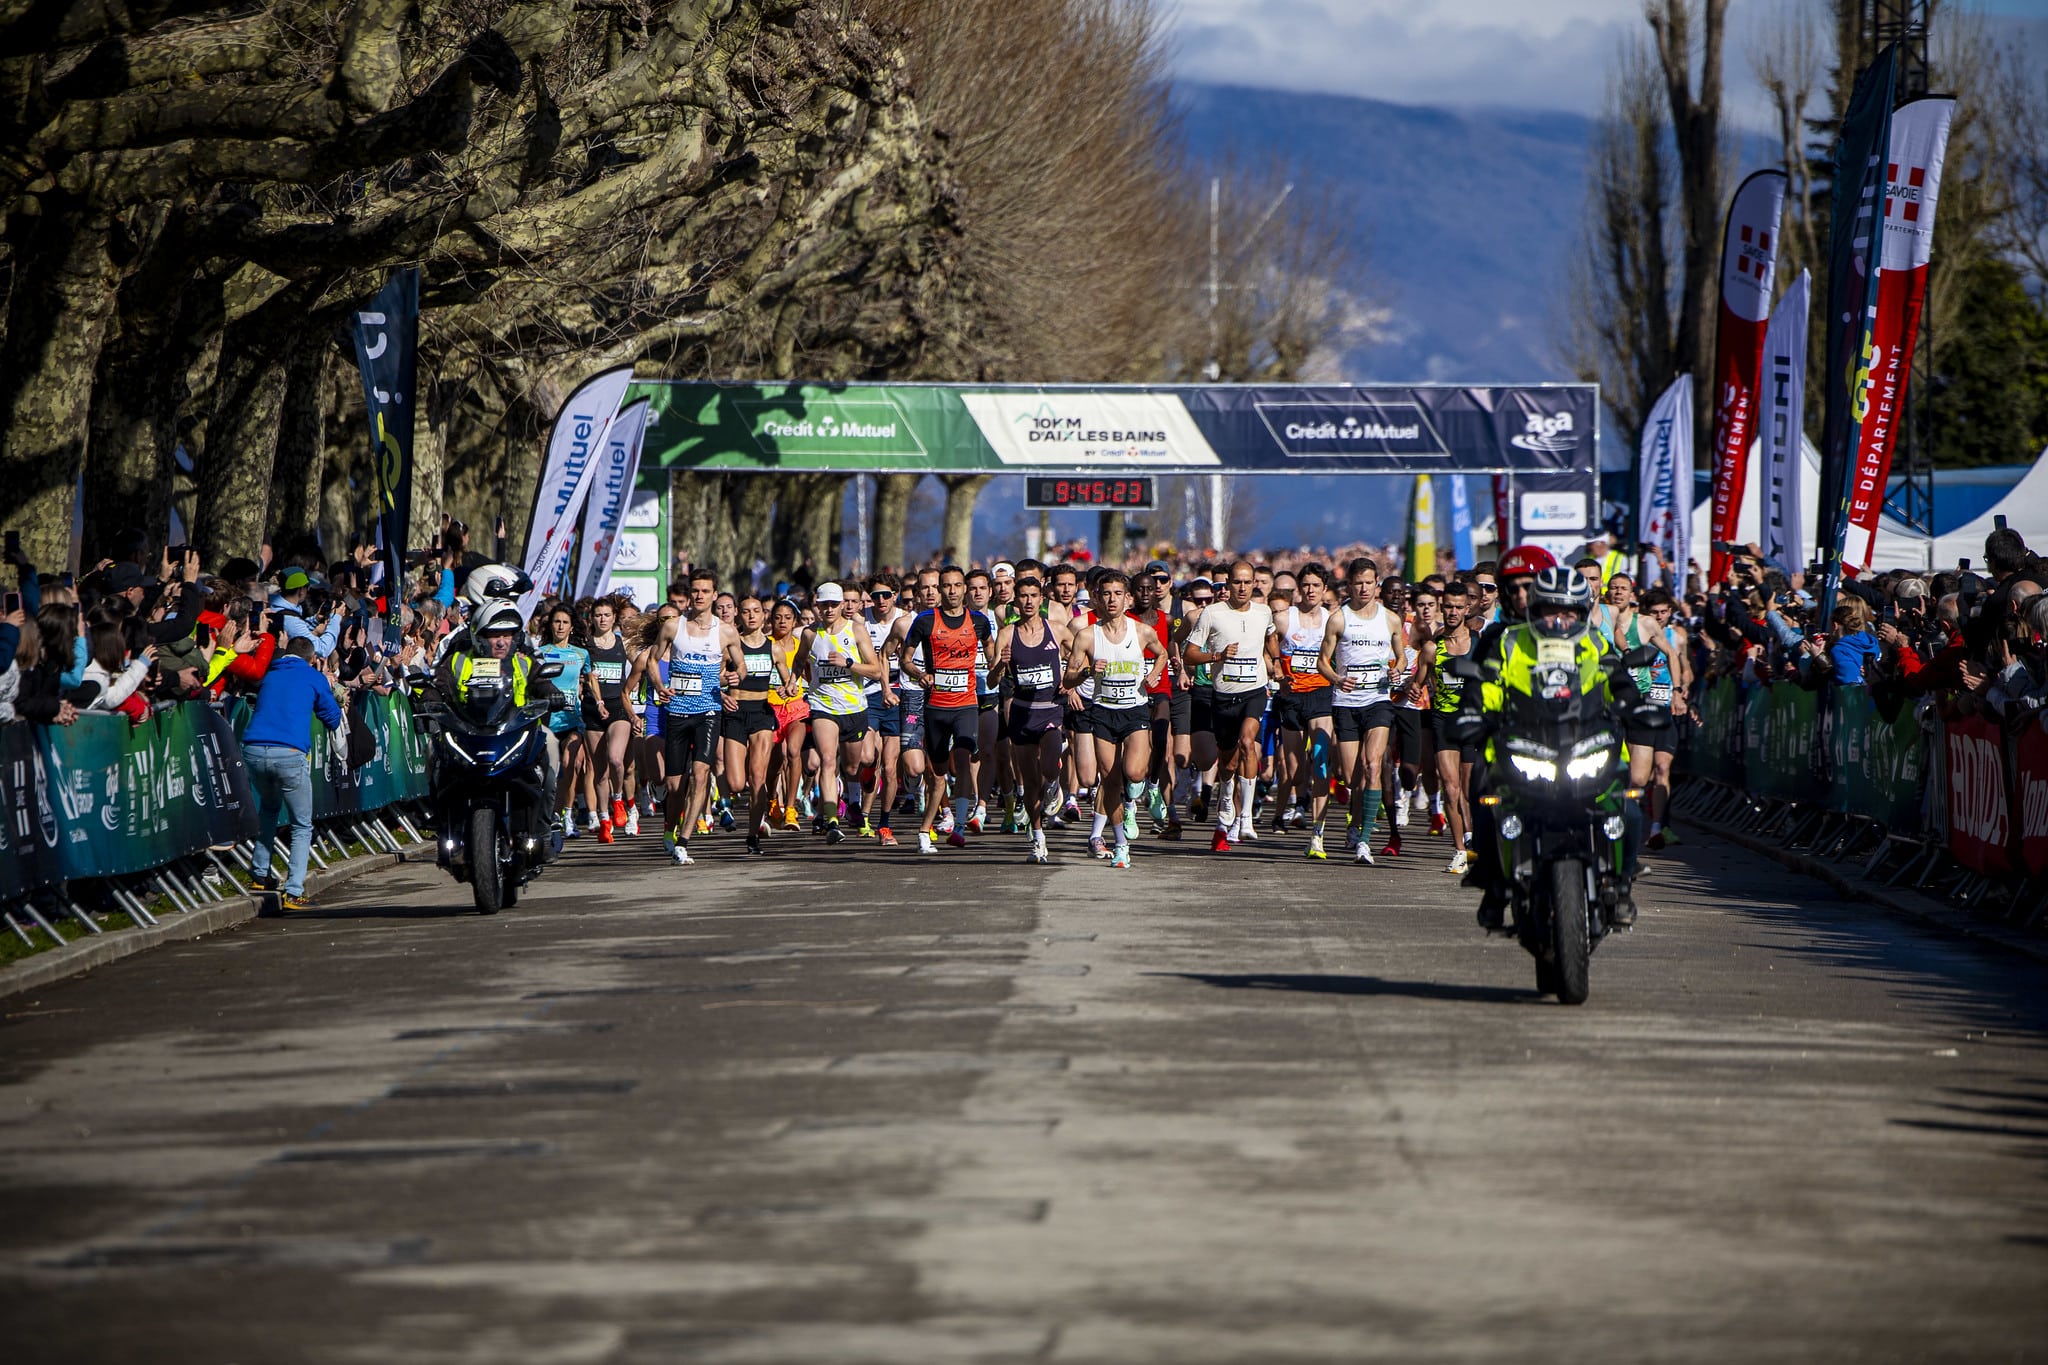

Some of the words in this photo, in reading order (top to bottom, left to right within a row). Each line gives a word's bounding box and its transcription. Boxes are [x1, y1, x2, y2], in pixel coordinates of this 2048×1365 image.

[1886, 183, 1919, 200] SAVOIE
[1885, 223, 1926, 237] PARTEMENT
[1033, 418, 1082, 429] 10KM
[1525, 411, 1574, 438] asa
[1860, 344, 1903, 492] DÉPARTEMENT
[763, 420, 814, 438] Crédit
[842, 422, 897, 438] Mutuel
[1078, 431, 1109, 442] LES
[1112, 431, 1167, 442] BAINS
[1285, 421, 1338, 439] Crédit
[1363, 423, 1419, 439] Mutuel
[554, 414, 594, 517] Mutuel
[1653, 418, 1673, 508] Mutuel
[600, 440, 626, 530] Mutuel
[1055, 480, 1143, 503] 9:45:23
[1851, 500, 1870, 523] LE
[683, 652, 708, 662] ASA
[1301, 656, 1315, 667] 39
[821, 667, 847, 677] 1464
[1104, 660, 1141, 676] STANCE
[680, 679, 690, 689] 17
[944, 675, 959, 686] 40
[1028, 672, 1043, 684] 22
[1361, 672, 1368, 683] 2
[1111, 687, 1126, 698] 35
[1949, 732, 2011, 848] HONDA
